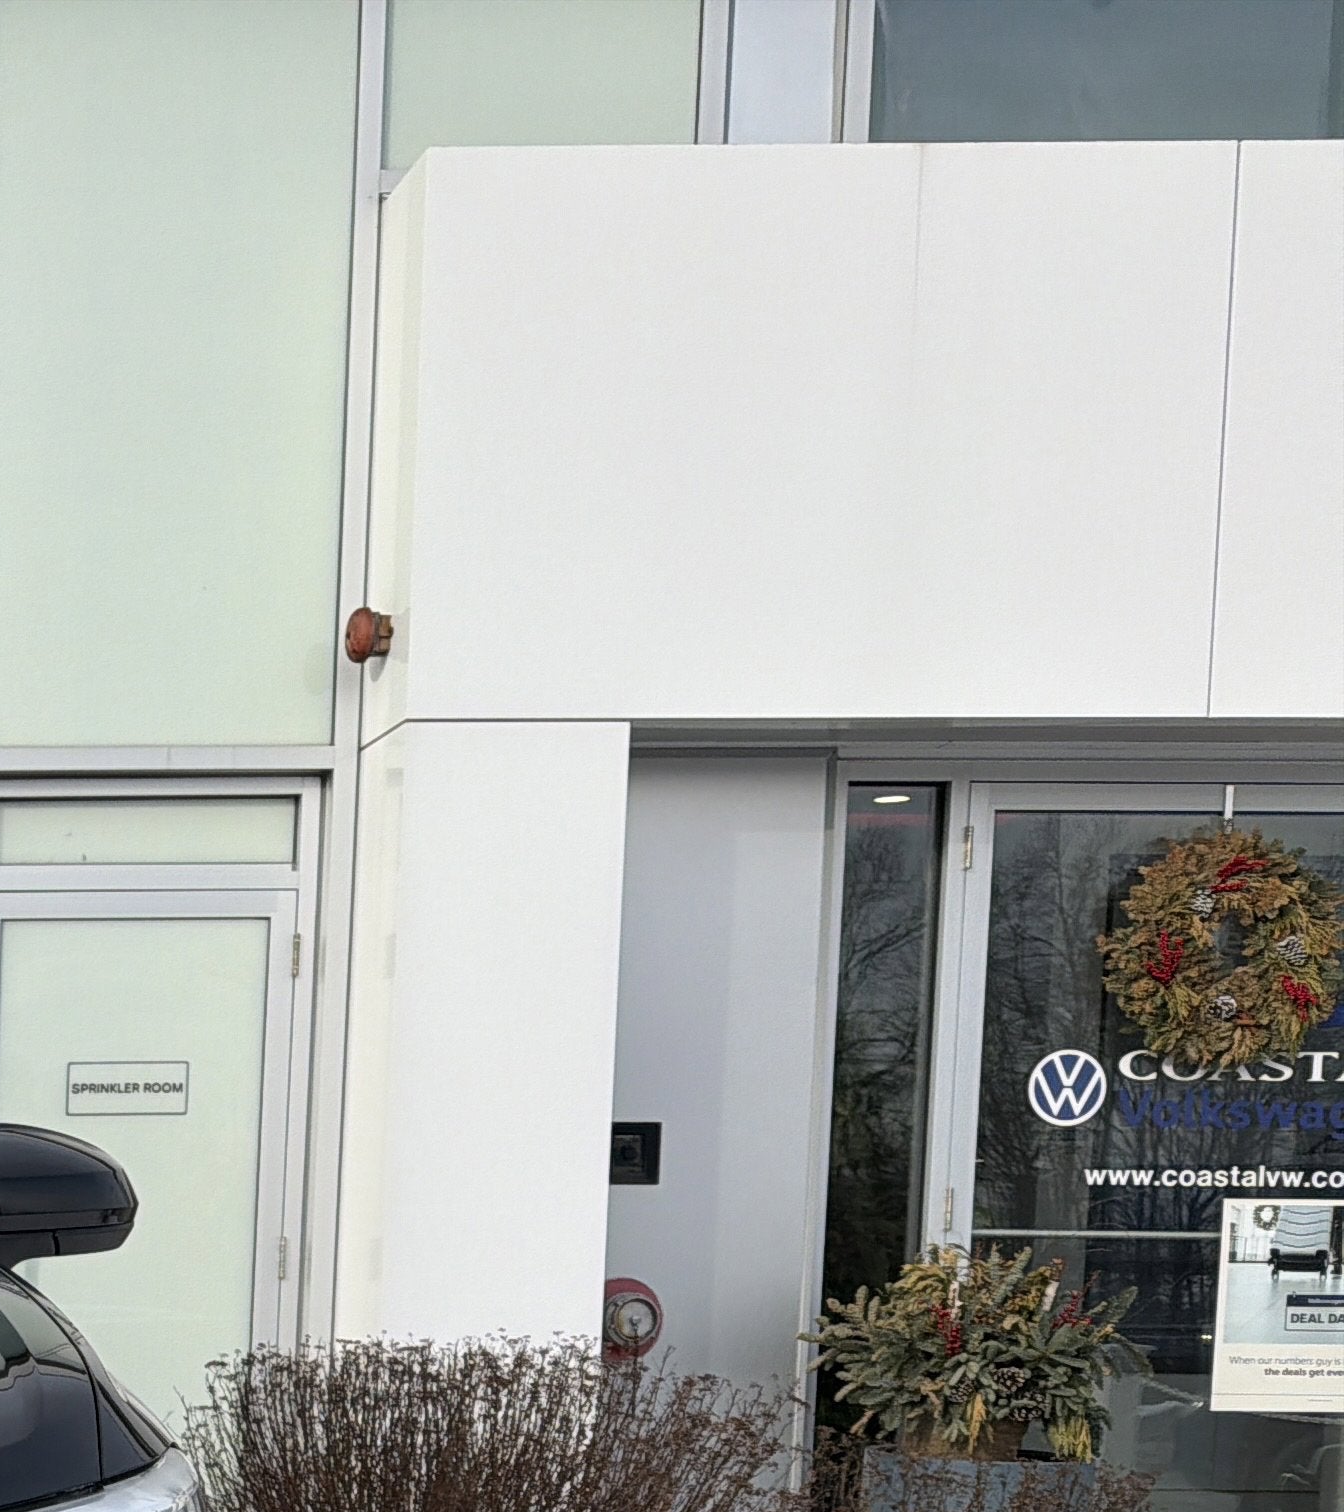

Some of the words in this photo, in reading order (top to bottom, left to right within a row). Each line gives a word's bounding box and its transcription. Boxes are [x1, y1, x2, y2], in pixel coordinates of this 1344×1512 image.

[1118, 1050, 1344, 1082] COAST
[72, 1082, 141, 1095] SPRINKLER
[143, 1082, 184, 1094] ROOM
[1290, 1313, 1325, 1324] DEAL
[1264, 1368, 1280, 1376] the
[1282, 1368, 1307, 1377] deals
[1308, 1368, 1325, 1378] get
